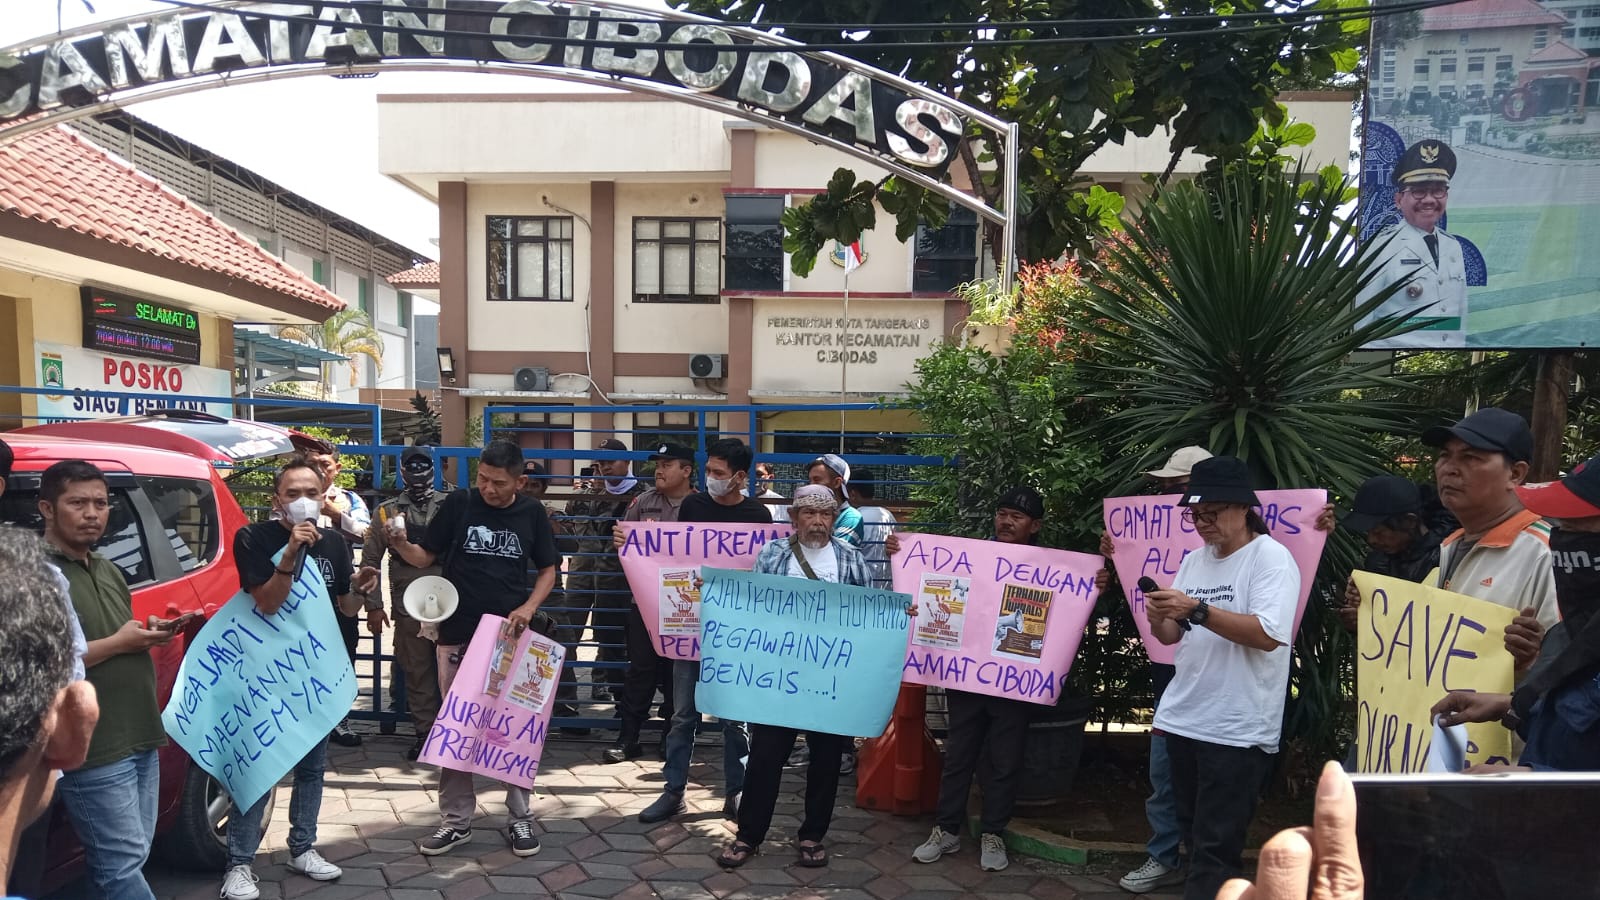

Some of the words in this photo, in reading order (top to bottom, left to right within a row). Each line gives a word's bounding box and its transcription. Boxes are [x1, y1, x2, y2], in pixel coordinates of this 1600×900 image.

[489, 1, 964, 168] CIBODAS
[136, 303, 186, 327] SELAMAT
[767, 317, 833, 329] PEMERINTAH
[835, 317, 863, 329] KOTA
[865, 318, 930, 330] TANGERANG
[776, 332, 833, 346] KANTOR
[836, 333, 920, 348] KECAMATAN
[817, 351, 878, 364] CIBODAS
[103, 358, 183, 392] POSKO
[73, 387, 128, 416] SIAG
[1109, 504, 1174, 540] CAMAT
[903, 540, 974, 575] ADA
[995, 556, 1094, 601] DENGAN
[704, 575, 827, 624] WALIKOTANYA
[702, 620, 853, 670] PEGAWAINYA
[1361, 588, 1488, 693] SAVE
[199, 631, 327, 767] MAENANNYA
